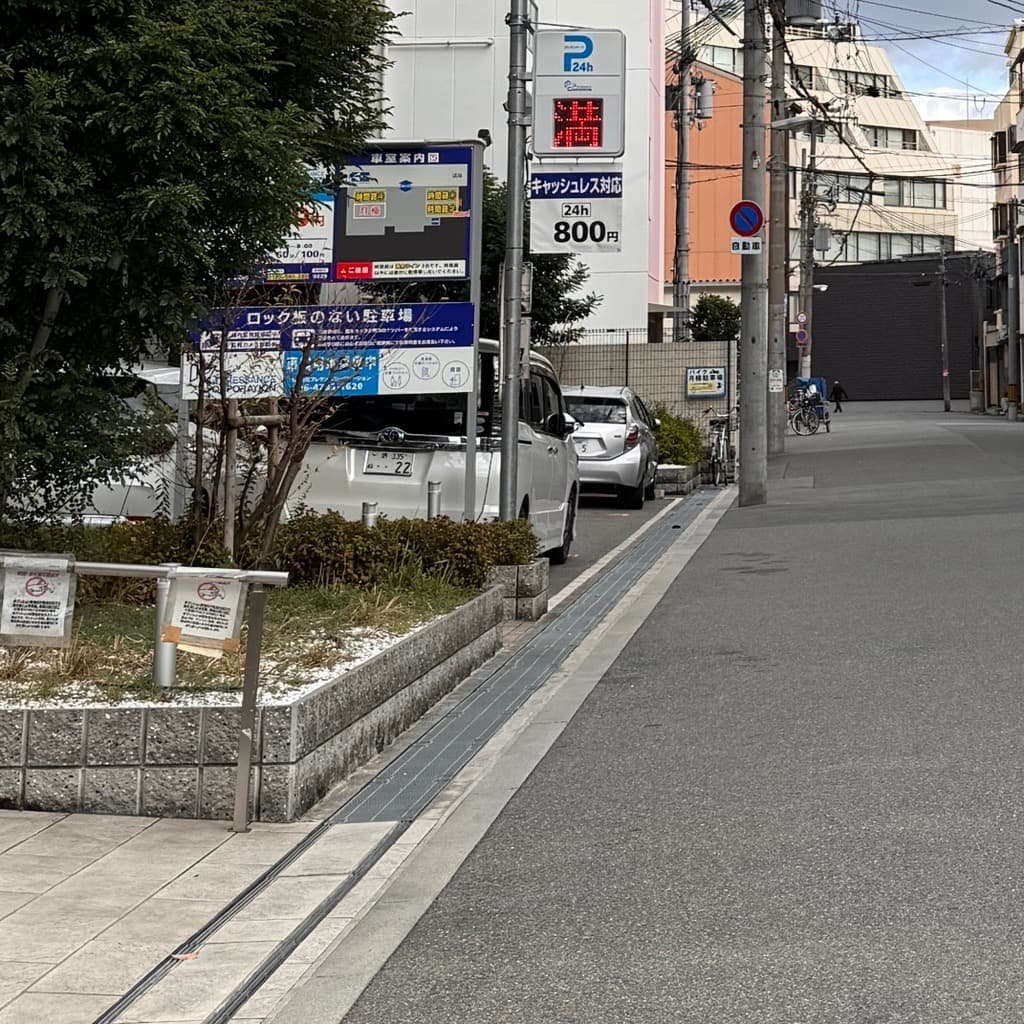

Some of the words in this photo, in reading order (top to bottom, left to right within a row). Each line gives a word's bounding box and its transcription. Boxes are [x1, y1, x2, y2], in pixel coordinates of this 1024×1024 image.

[572, 62, 593, 72] 24h
[531, 177, 623, 195] キャッシュレス対応
[564, 205, 589, 217] 24h
[554, 221, 619, 244] 800円
[394, 461, 411, 474] 22
